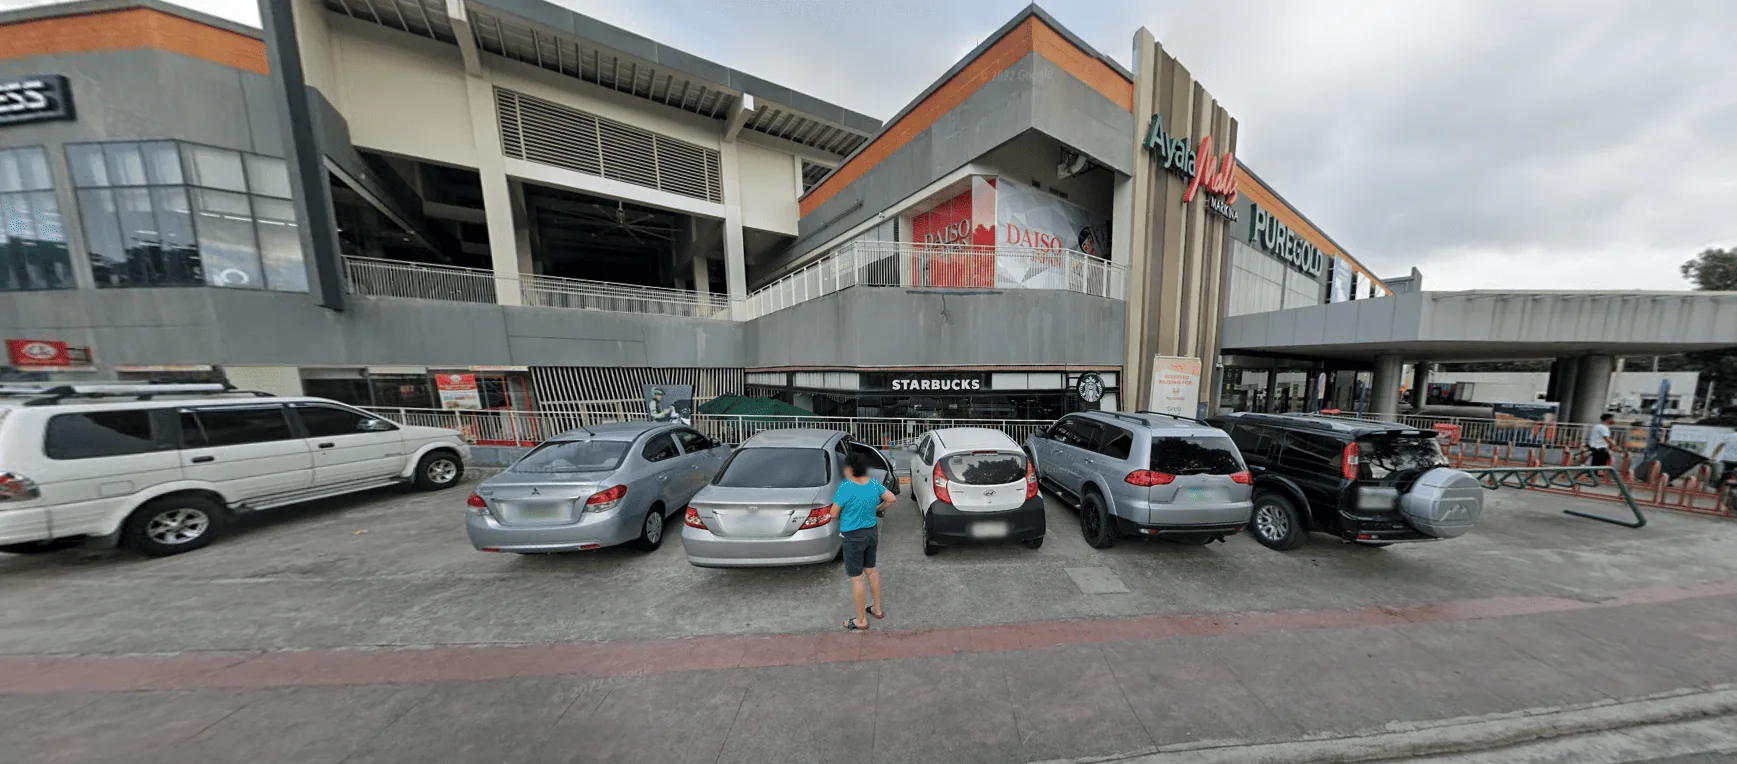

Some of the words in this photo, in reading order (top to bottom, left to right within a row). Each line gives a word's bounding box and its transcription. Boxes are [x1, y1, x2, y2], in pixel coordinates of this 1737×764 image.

[1145, 113, 1196, 178] Ayala
[1184, 135, 1238, 204] Malls
[925, 219, 970, 250] DAISO
[1006, 223, 1062, 255] DAISO
[1250, 203, 1323, 277] PUREGOLD
[891, 379, 980, 390] STARBUCKS
